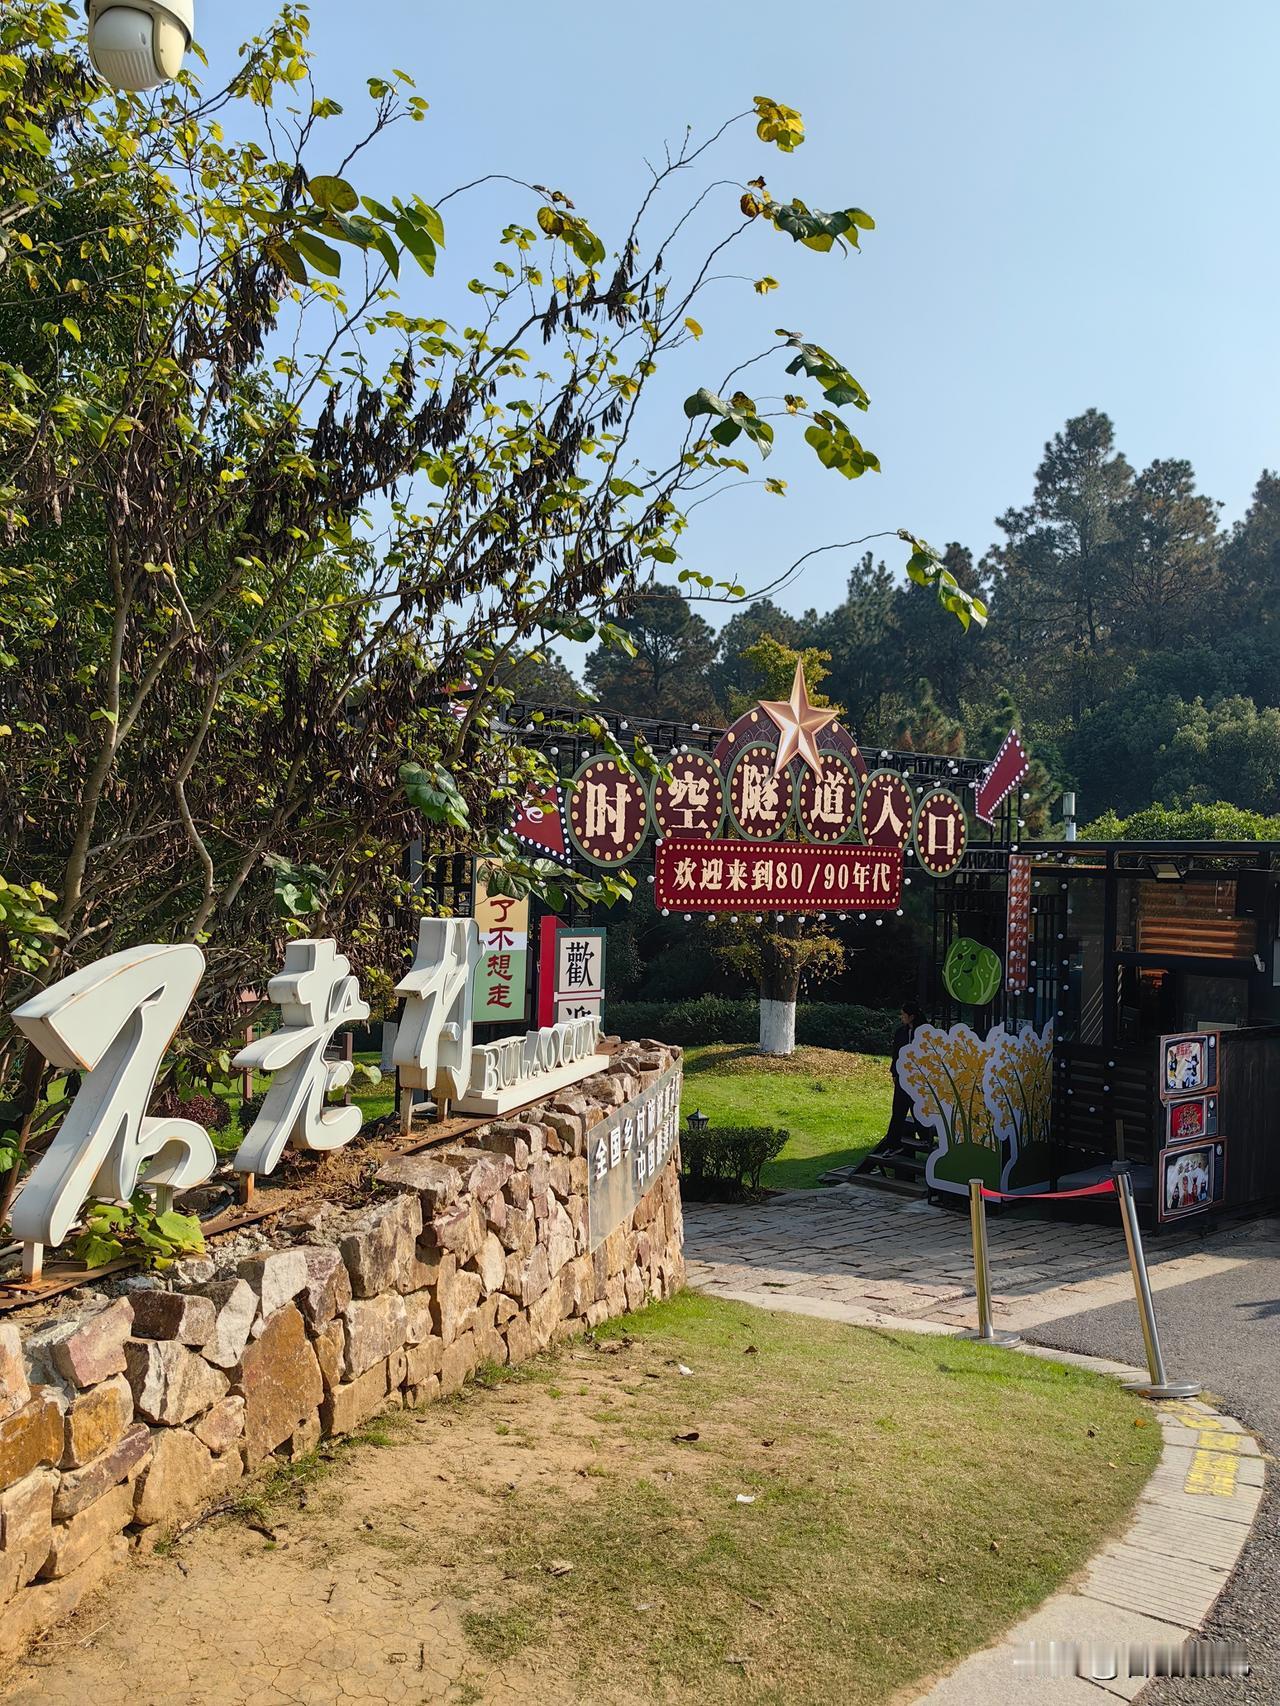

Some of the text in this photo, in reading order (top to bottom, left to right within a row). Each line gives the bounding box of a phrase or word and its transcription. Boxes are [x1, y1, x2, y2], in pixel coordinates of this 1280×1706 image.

[585, 763, 957, 857] 时空隧道入口
[672, 856, 892, 895] 欢迎来到80/90年代
[486, 899, 515, 1009] 了不想走
